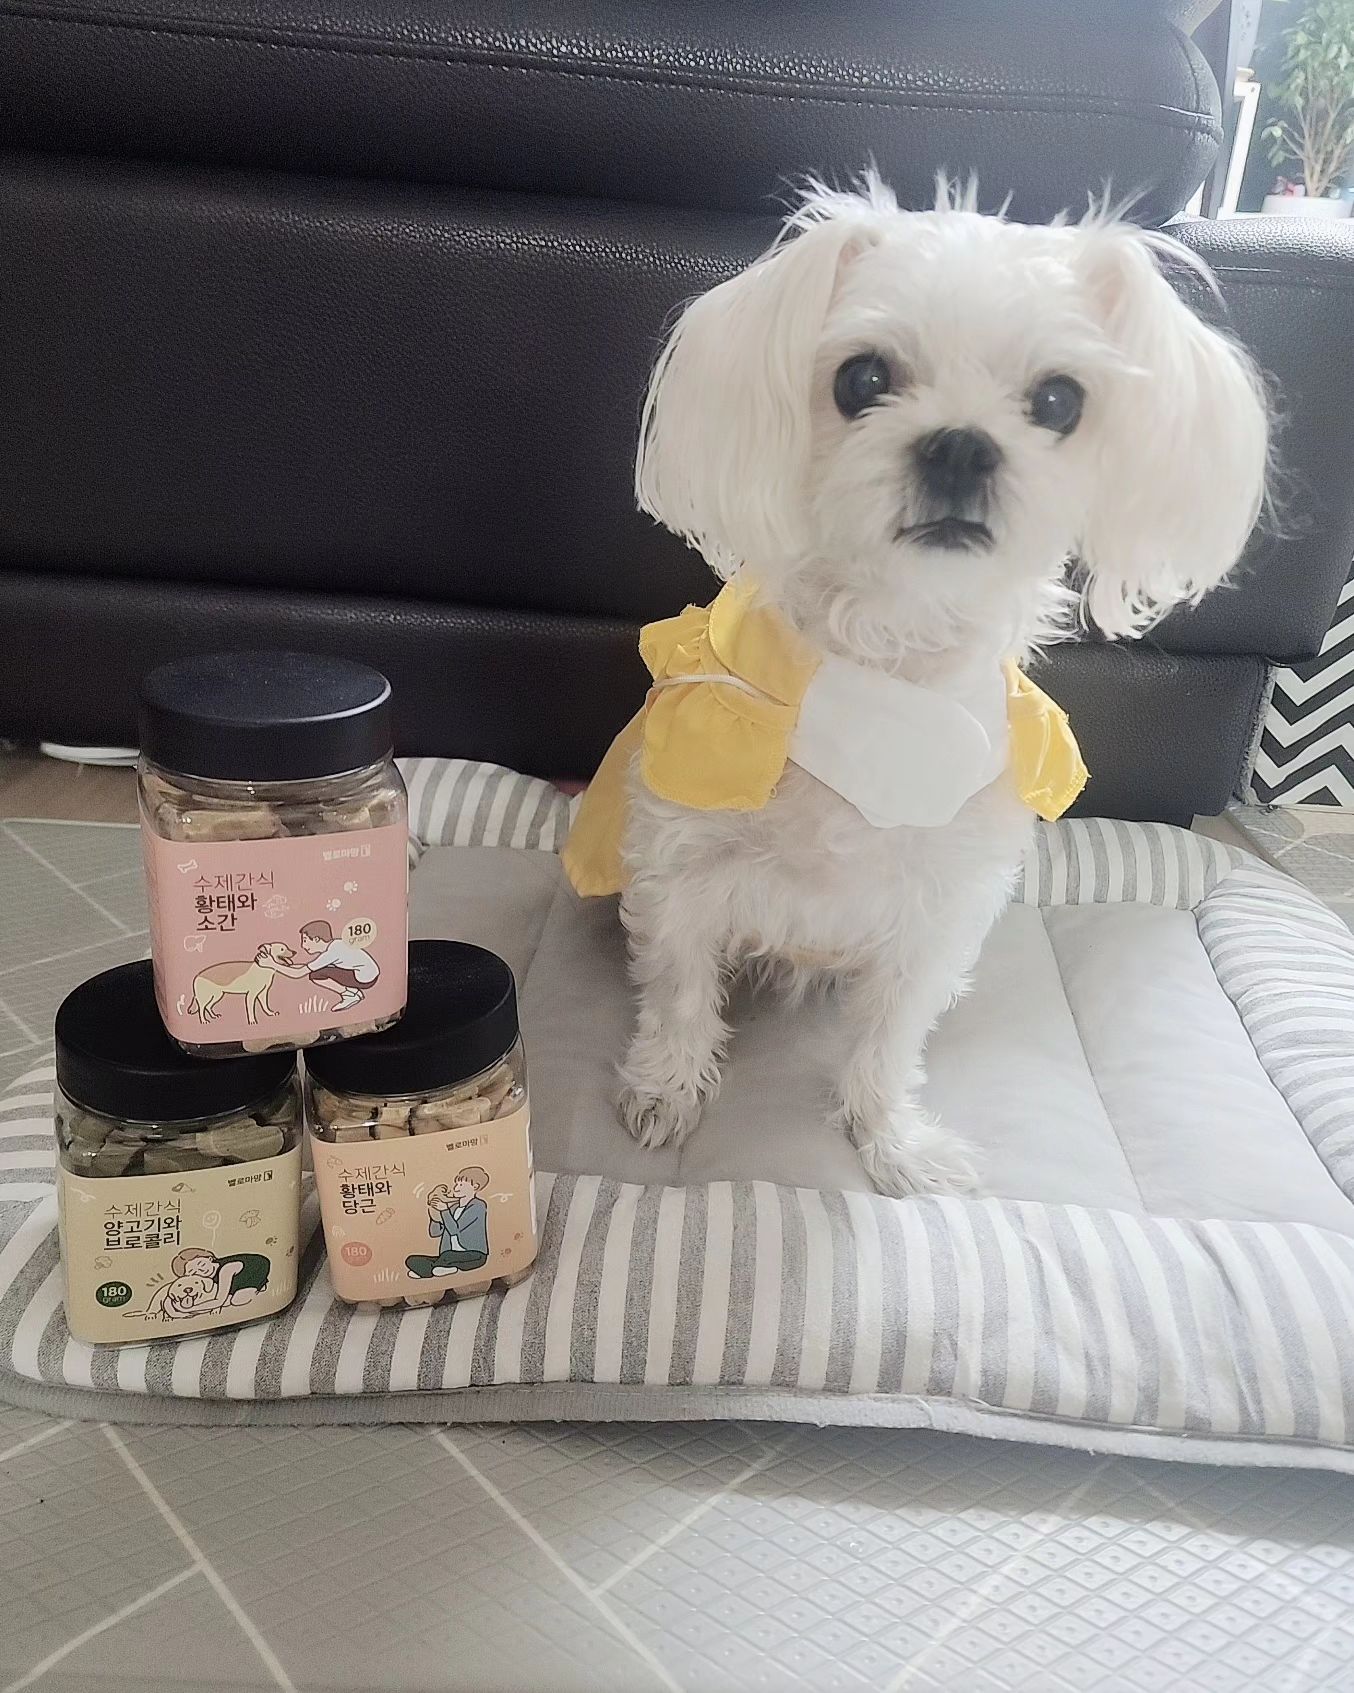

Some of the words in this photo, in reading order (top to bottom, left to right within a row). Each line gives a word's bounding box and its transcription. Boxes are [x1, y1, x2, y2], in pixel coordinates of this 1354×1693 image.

[193, 869, 275, 893] 수제간식
[195, 892, 258, 914] 황태와
[196, 913, 238, 932] 소간
[348, 923, 372, 936] 180
[348, 935, 371, 946] gram
[338, 1162, 406, 1182] 수제간식
[339, 1180, 393, 1198] 황태와
[104, 1199, 181, 1219] 수제간식
[342, 1198, 377, 1214] 당근
[103, 1215, 182, 1236] 양고기와
[103, 1231, 181, 1250] 브로콜리
[345, 1246, 367, 1256] 180
[101, 1286, 127, 1298] 180
